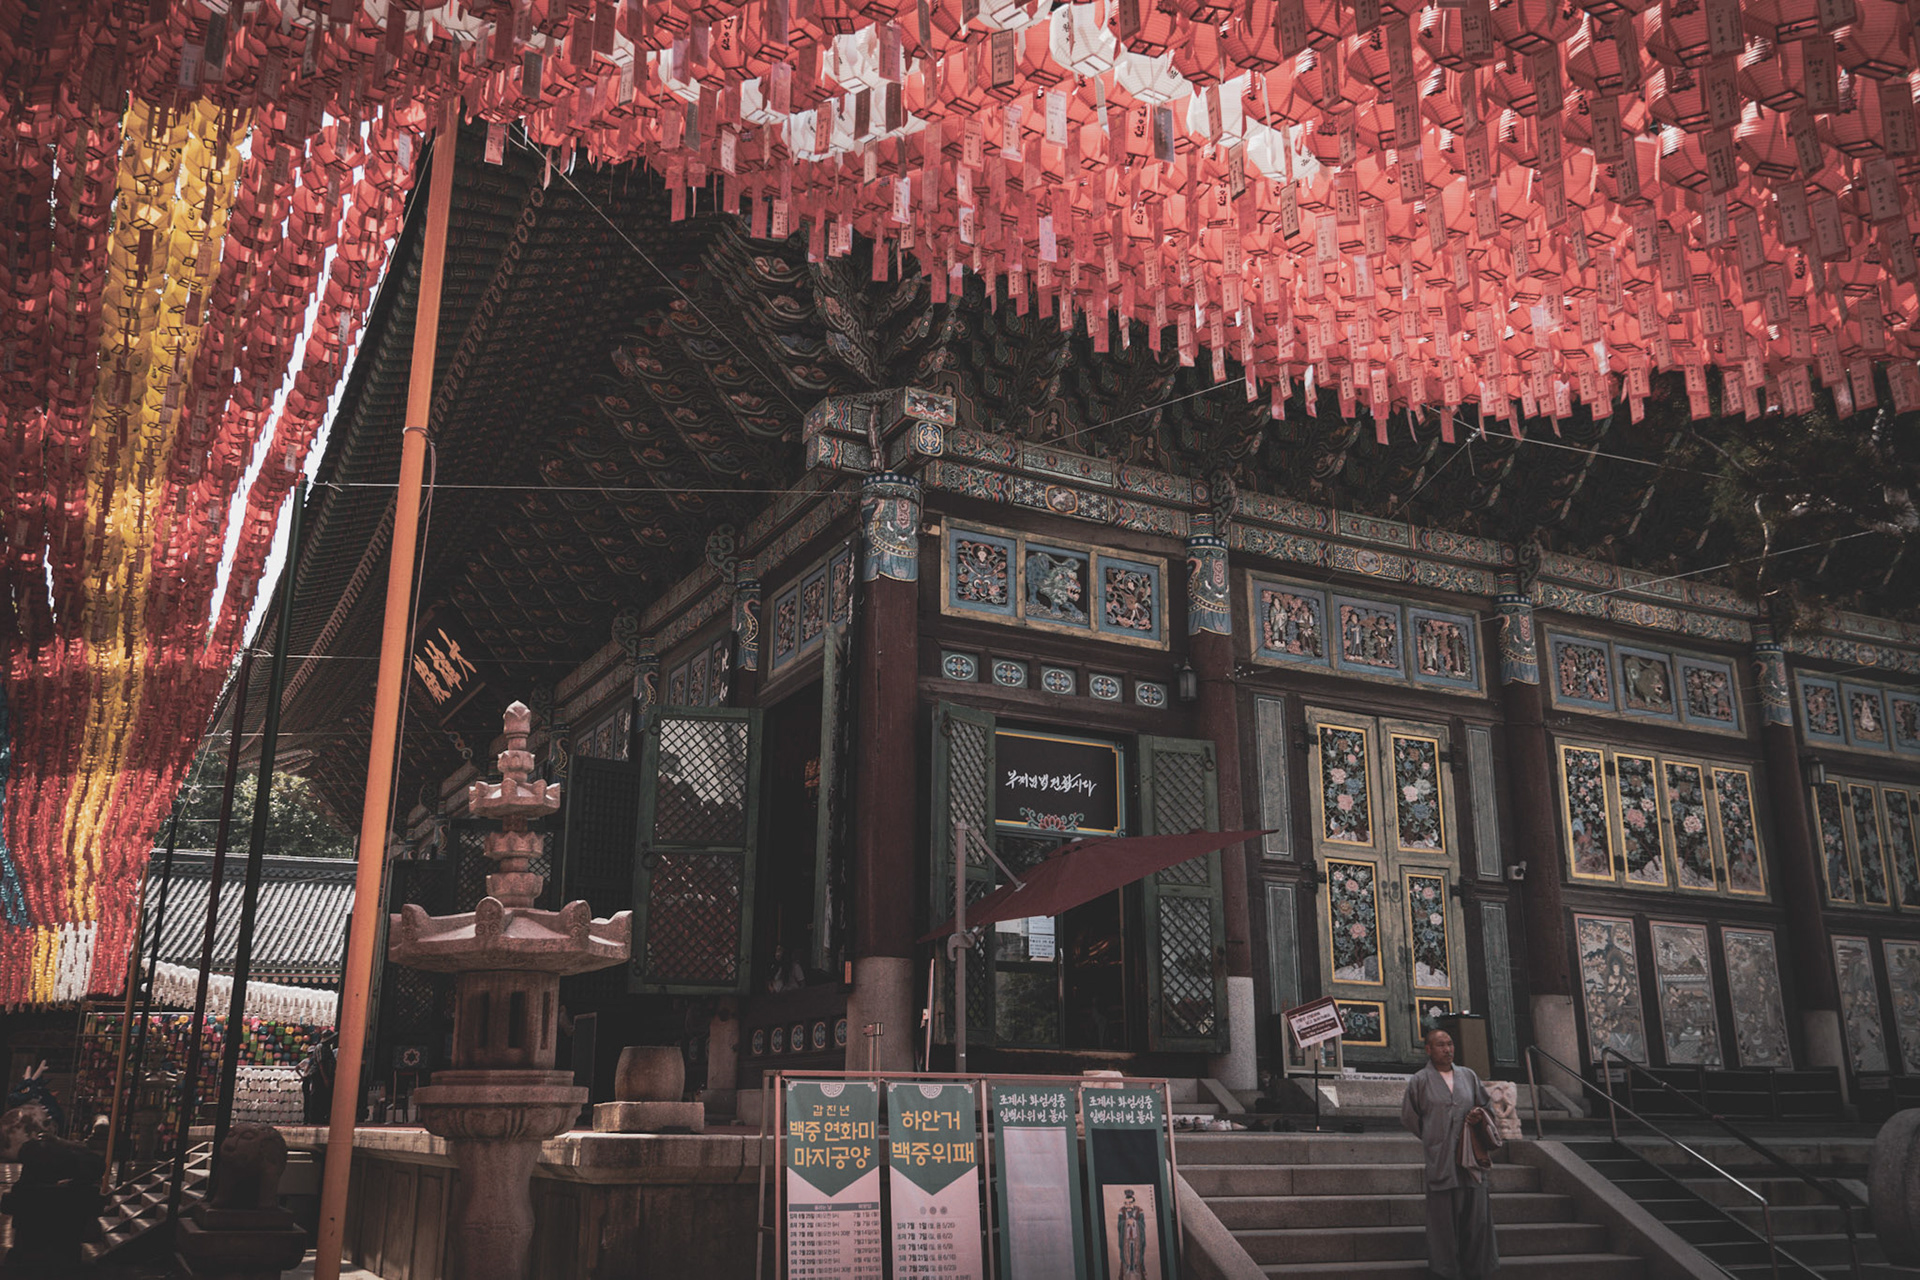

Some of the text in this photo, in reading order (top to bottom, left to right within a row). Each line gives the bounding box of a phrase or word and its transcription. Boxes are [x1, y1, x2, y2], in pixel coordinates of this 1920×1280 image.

[999, 1094, 1027, 1107] 조계사
[1089, 1096, 1116, 1107] 조계사
[789, 1120, 875, 1142] 백중 연화미
[901, 1109, 961, 1132] 하안거
[794, 1145, 871, 1170] 마지공양
[891, 1141, 975, 1167] 백중위패
